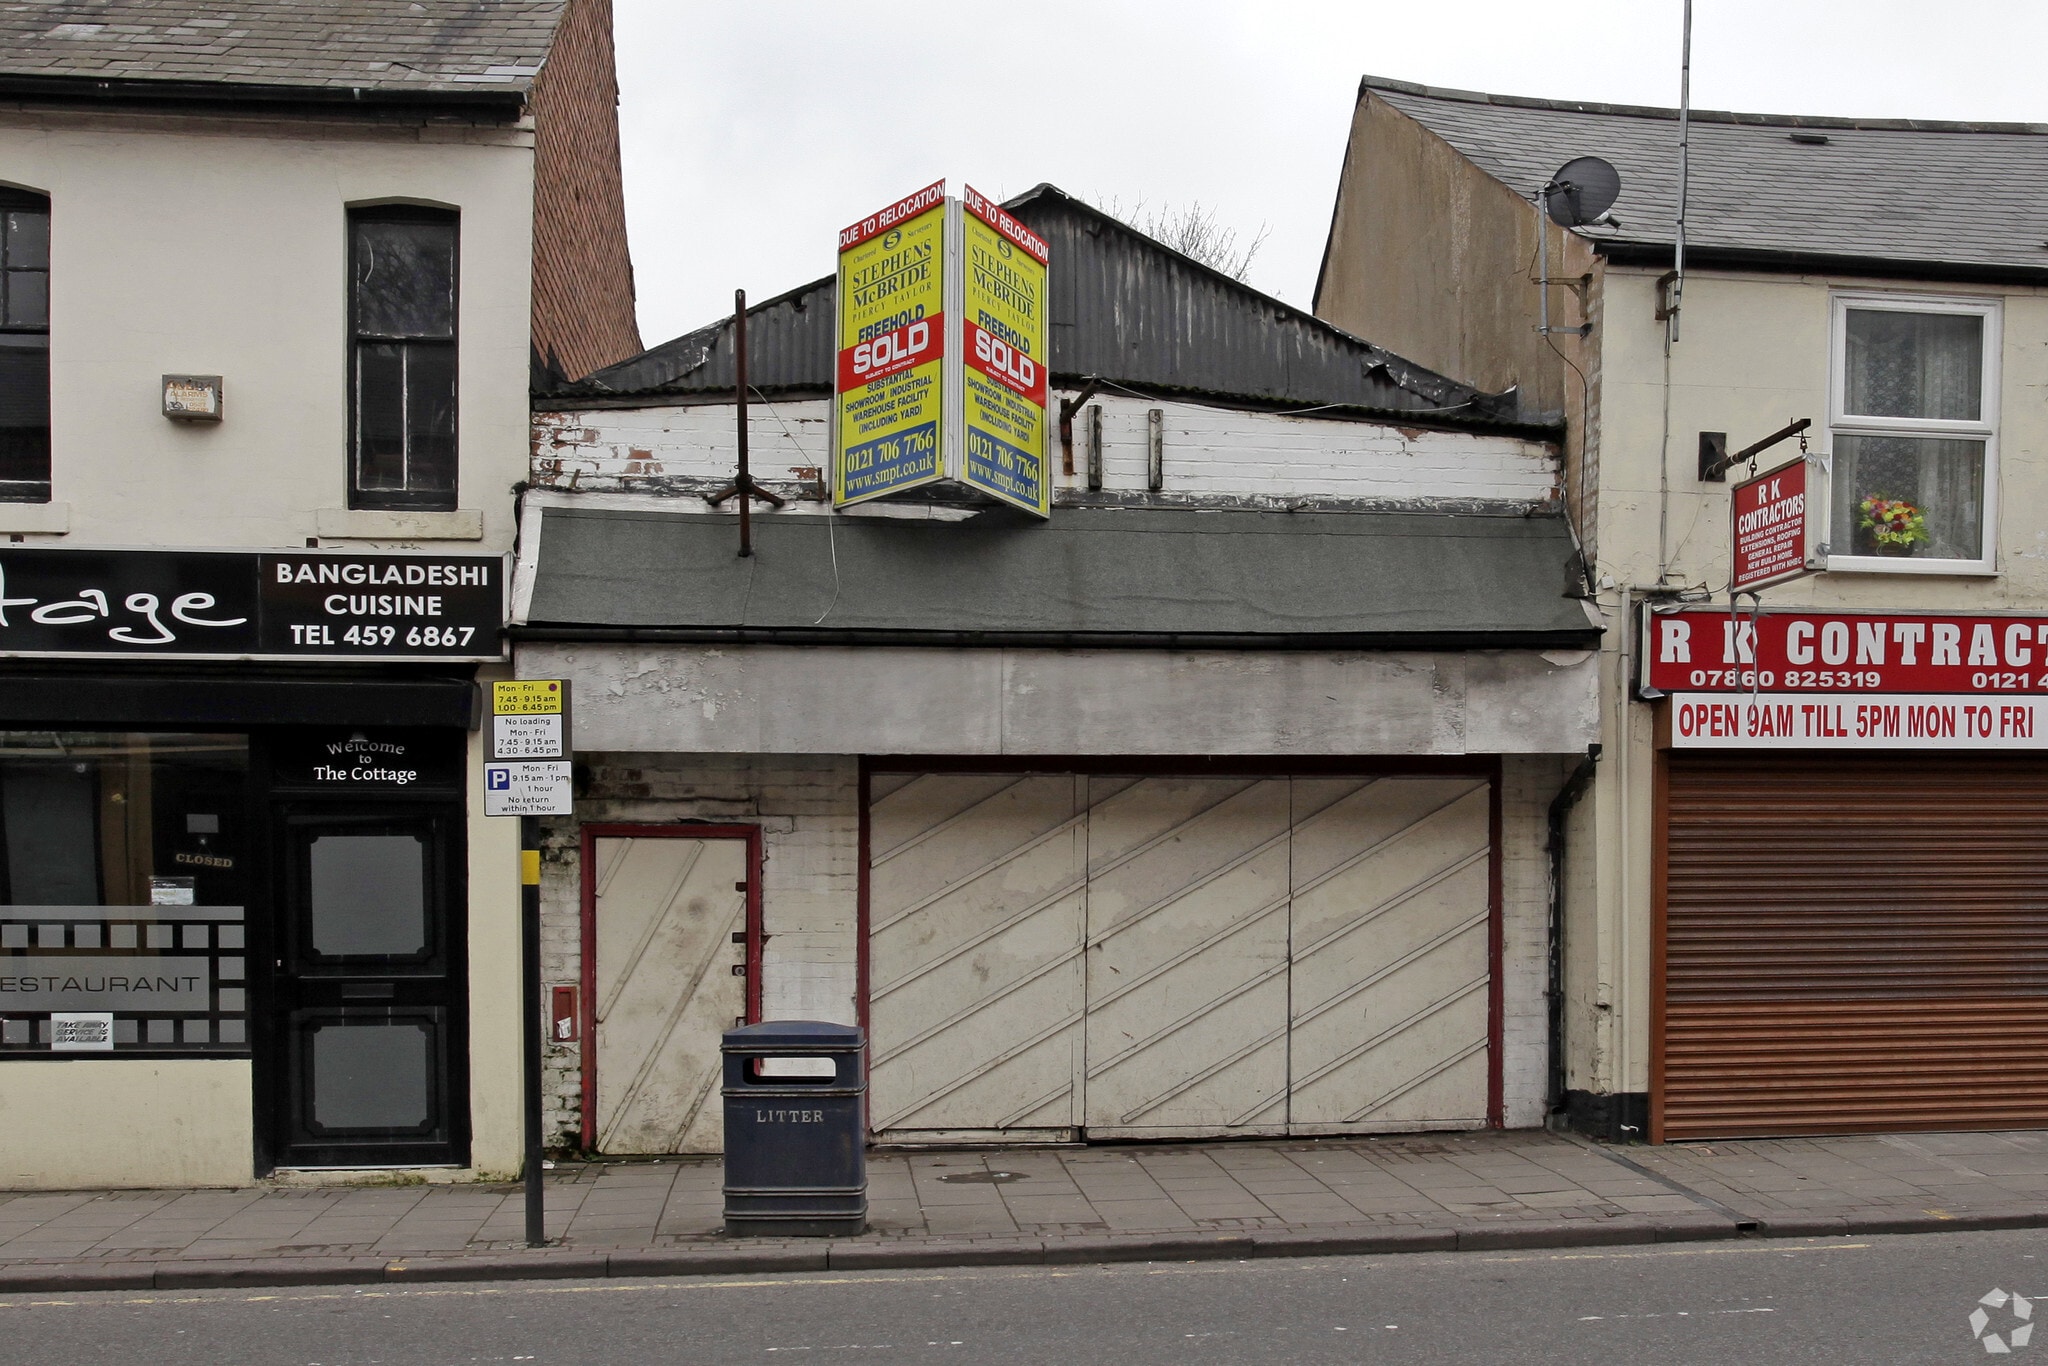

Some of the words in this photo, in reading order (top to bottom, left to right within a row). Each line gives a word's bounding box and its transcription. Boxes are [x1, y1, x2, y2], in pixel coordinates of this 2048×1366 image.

[840, 226, 859, 247] DUE
[862, 218, 876, 236] TO
[879, 182, 945, 228] RELOCATION
[965, 188, 983, 214] DUE
[985, 202, 997, 224] TO
[999, 213, 1049, 262] RELOCATION
[853, 239, 932, 289] STEPHENS
[972, 244, 1034, 299] STEPHENS
[853, 261, 932, 310] McBRIDE
[973, 267, 1034, 320] McBRIDE
[853, 303, 886, 322] PIERCY
[895, 282, 932, 305] TAYLOR
[973, 287, 1001, 311] PIERCY
[1007, 309, 1035, 333] TAYLOR
[859, 304, 925, 343] FREEHOLD
[978, 308, 1030, 354] FREEHOLD
[853, 321, 929, 374] SOLD
[975, 328, 1034, 388] SOLD
[865, 369, 884, 380] SUBJECT
[892, 358, 916, 370] CONTRACT
[867, 369, 914, 393] SUBSTANTIAL
[845, 391, 885, 413] SHOWROOM
[890, 375, 932, 397] INDUSTRIAL
[967, 376, 1002, 403] SHOWROOM
[1005, 397, 1037, 422] INDUSTRIAL
[986, 376, 1023, 402] SUBSTANTIAL
[853, 401, 895, 422] WAREHOUSE
[897, 388, 929, 407] FACILITY
[974, 393, 1010, 420] WAREHOUSE
[1011, 410, 1034, 432] FACILITY
[859, 413, 898, 434] (INCLUDING
[900, 404, 922, 420] YARD)
[847, 447, 874, 473] 0121
[877, 438, 900, 464] 706
[904, 428, 934, 455] 7766
[970, 433, 993, 461] 0121
[995, 444, 1013, 470] 706
[1016, 454, 1038, 481] 7766
[846, 452, 933, 492] www.smpt.co.uk
[969, 460, 1038, 501] www.smpt.co.uk
[1758, 484, 1767, 505] R
[1771, 478, 1781, 500] K
[1738, 493, 1804, 535] CONTRACTORS
[1740, 530, 1764, 544] BUILDING
[1765, 517, 1803, 537] CONTRACTOR
[1741, 537, 1776, 554] EXTENSIONS,
[1777, 527, 1801, 542] ROOFING
[1747, 546, 1772, 561] GENERAL
[1773, 540, 1793, 553] REPAIR
[1747, 560, 1760, 570] NEW
[1761, 554, 1776, 566] BUILD
[1777, 549, 1793, 561] HOME
[276, 563, 488, 586] BANGLADESHI
[1738, 566, 1770, 582] REGISTERED
[1772, 561, 1786, 573] WITH
[1787, 556, 1802, 568] NHBC
[324, 594, 442, 616] CUISINE
[290, 625, 335, 645] TEL
[343, 625, 396, 646] 459
[405, 626, 476, 647] 6867
[1660, 619, 1691, 663] R
[1722, 620, 1755, 664] K
[1690, 669, 1775, 687] 07860
[1784, 670, 1881, 688] 825319
[1972, 672, 2029, 689] 0121
[520, 717, 551, 725] loading
[522, 703, 542, 711] 6.45
[544, 704, 557, 712] pm
[1679, 703, 1739, 737] OPEN
[1747, 704, 1793, 737] 9AM
[1801, 704, 1848, 738] TILL
[1856, 705, 1900, 738] 5PM
[1908, 705, 1956, 738] MON
[1964, 705, 1993, 738] TO
[2000, 706, 2033, 738] FRI
[326, 741, 405, 755] Welcome
[359, 754, 372, 764] to
[524, 746, 545, 754] 6.45
[546, 747, 559, 755] pm
[313, 765, 347, 780] The
[351, 767, 417, 785] Cottage
[492, 770, 507, 789] P
[512, 774, 530, 782] 9.15
[175, 853, 233, 868] CLOSED
[0, 976, 200, 992] ESTAURANT
[756, 1109, 824, 1123] LITTER
